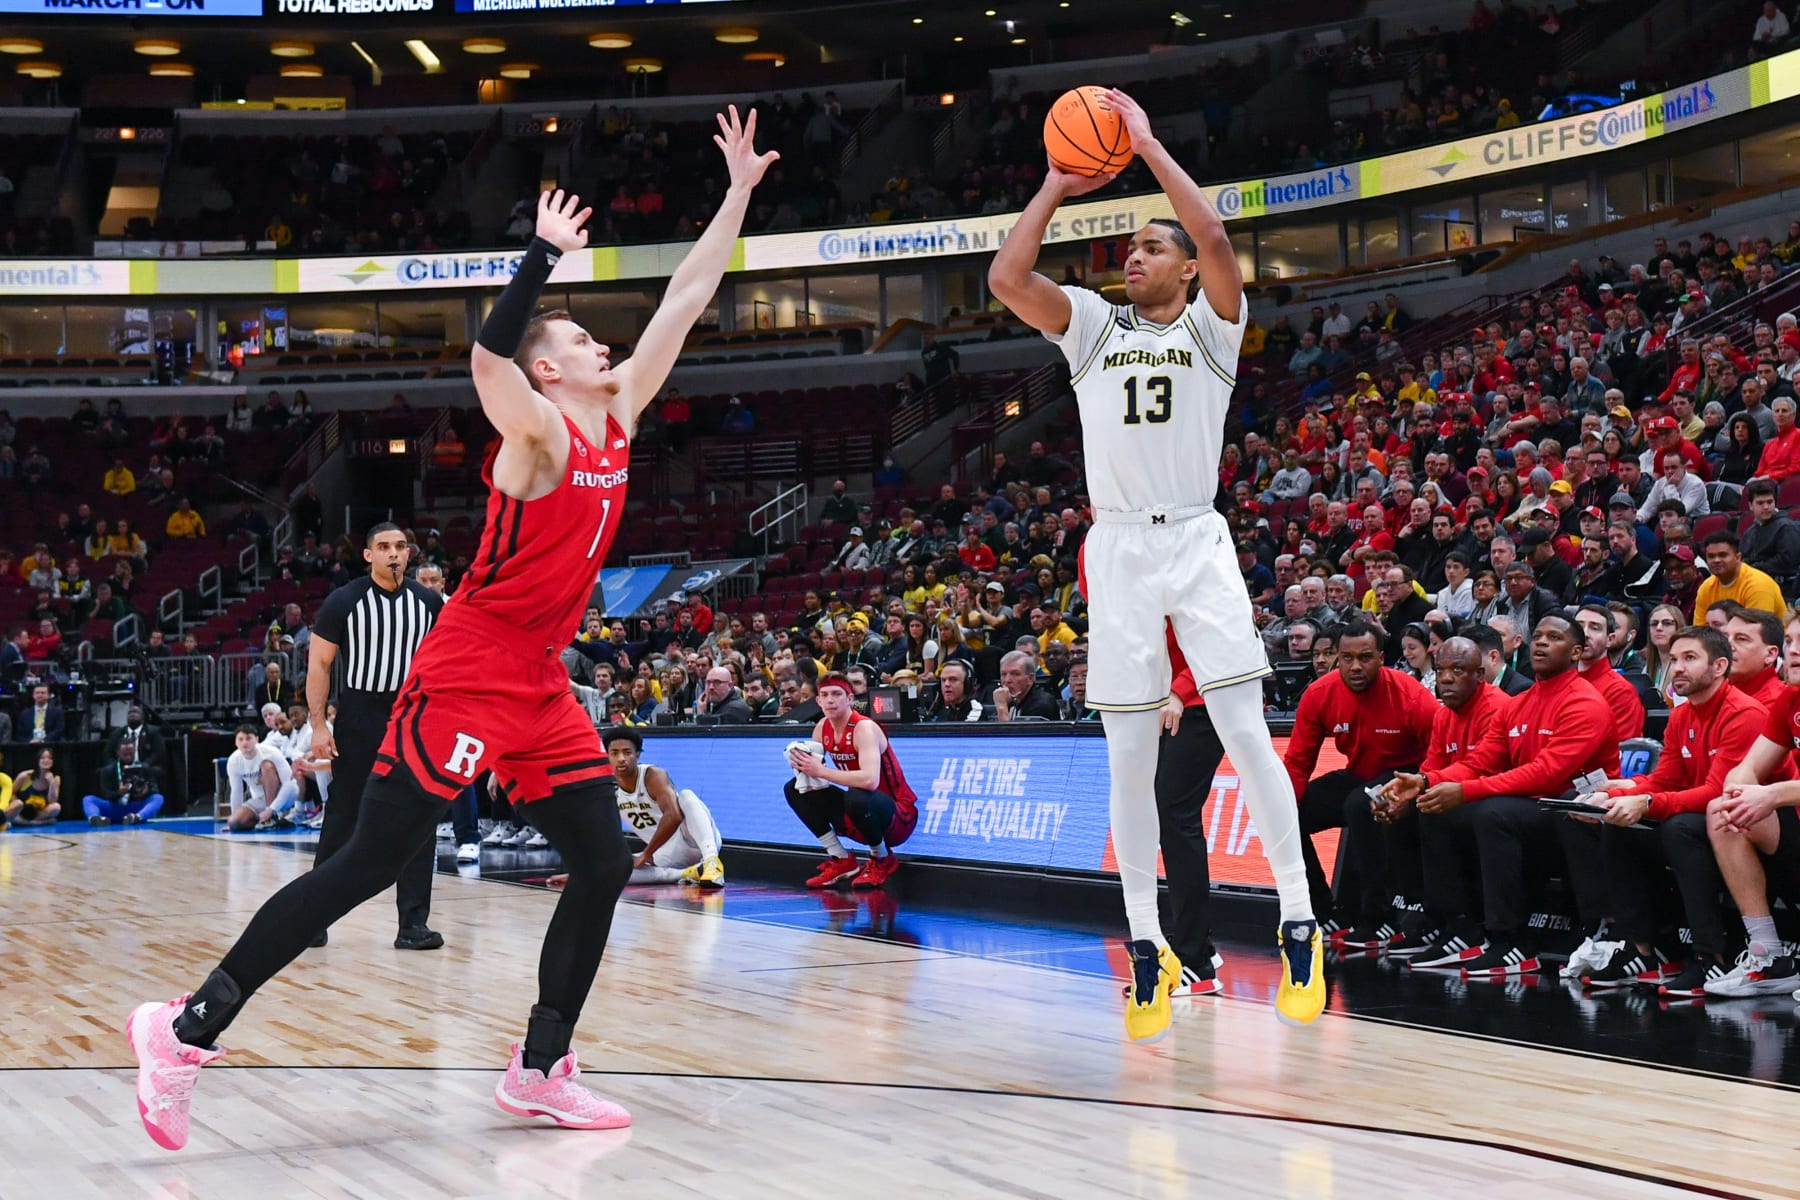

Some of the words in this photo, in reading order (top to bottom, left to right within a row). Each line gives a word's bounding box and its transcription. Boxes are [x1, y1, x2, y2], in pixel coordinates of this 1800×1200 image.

[1483, 119, 1597, 166] CLIFFS
[1217, 172, 1333, 217] Continental
[1103, 349, 1192, 371] MICHIGAN
[1123, 375, 1174, 425] 13
[586, 499, 611, 559] 1
[1151, 514, 1166, 525] M
[443, 731, 486, 779] R
[957, 759, 1031, 797] RETIRE
[627, 811, 657, 830] 25
[949, 799, 1069, 844] INEQUALITY
[1528, 913, 1549, 928] BIG
